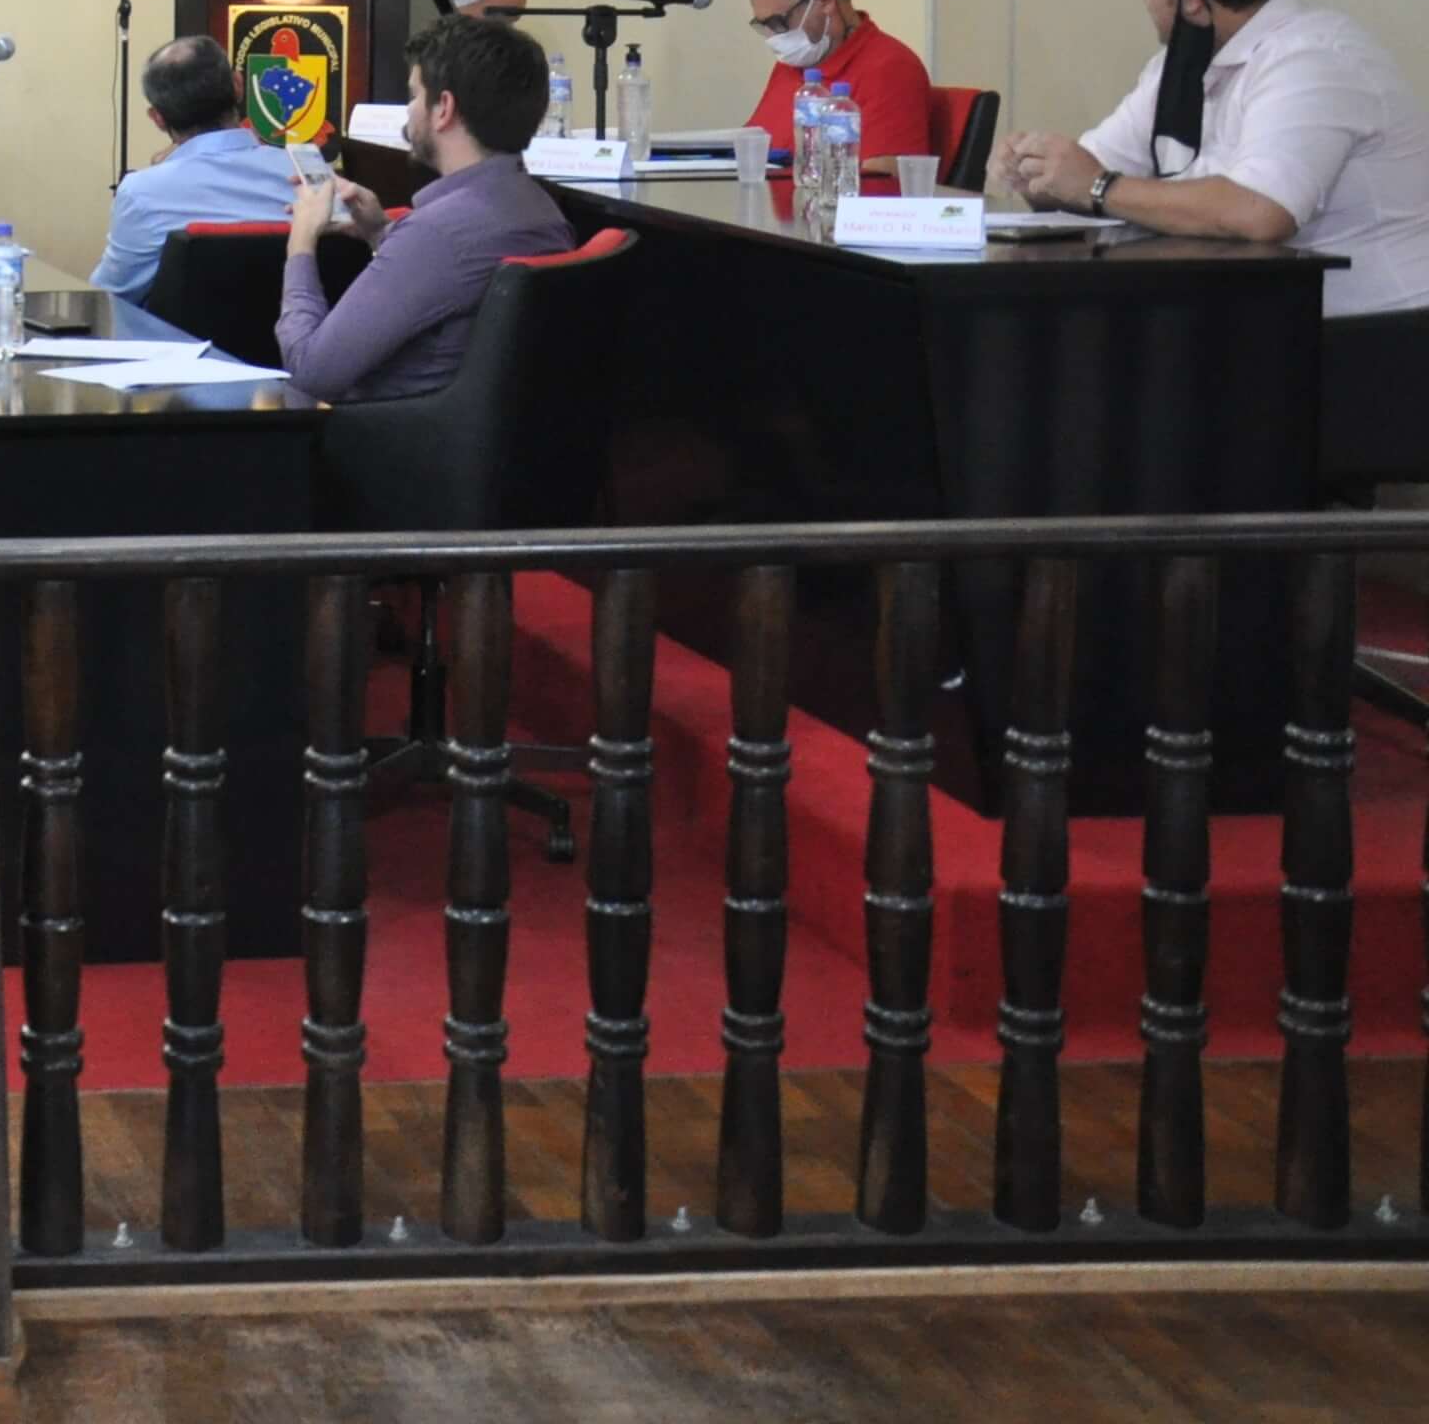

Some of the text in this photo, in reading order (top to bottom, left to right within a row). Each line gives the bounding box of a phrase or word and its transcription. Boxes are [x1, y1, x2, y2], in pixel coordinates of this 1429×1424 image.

[235, 14, 340, 73] PODER LEGISLATIVO MUNICIPAL
